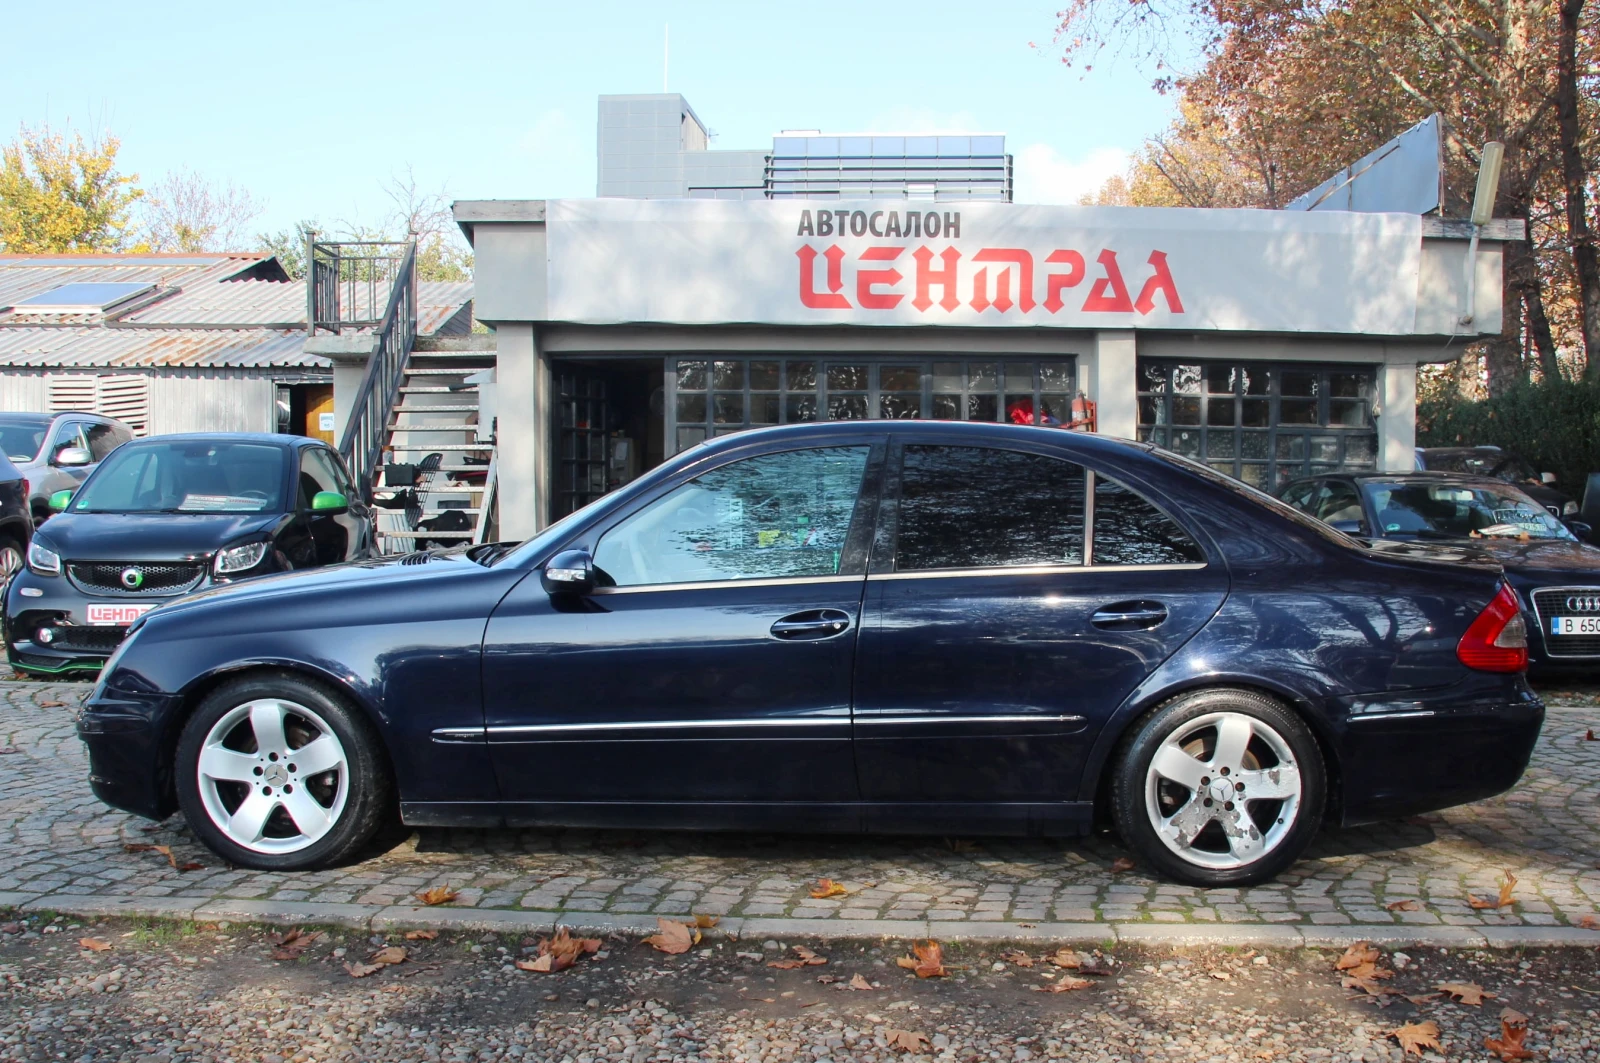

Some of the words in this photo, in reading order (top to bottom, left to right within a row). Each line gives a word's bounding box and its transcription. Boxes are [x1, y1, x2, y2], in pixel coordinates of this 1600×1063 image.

[798, 209, 961, 239] АВТОСАЛОН
[795, 244, 1184, 315] ЦЕНТРАЛ
[1565, 618, 1574, 632] B
